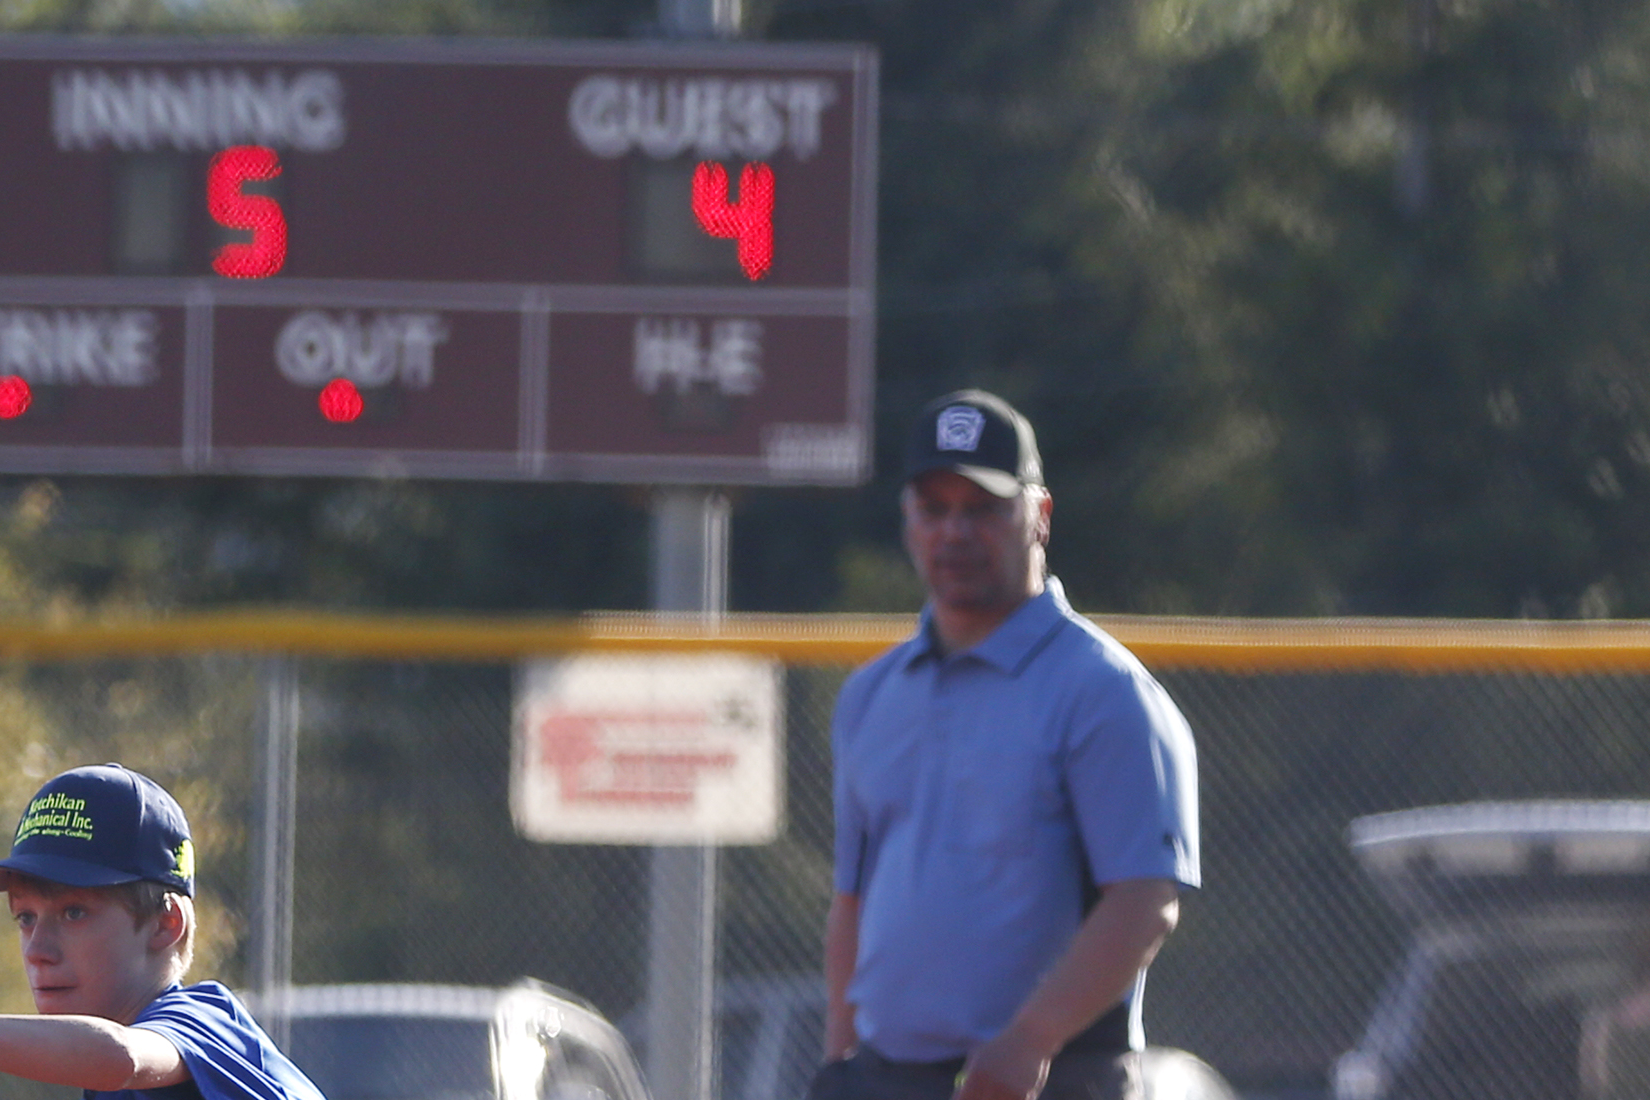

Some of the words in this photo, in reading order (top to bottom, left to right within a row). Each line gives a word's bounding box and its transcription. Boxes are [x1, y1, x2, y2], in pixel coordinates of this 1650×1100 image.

[52, 68, 346, 152] INNING
[568, 74, 836, 160] GUEST
[207, 145, 288, 278] 5
[691, 159, 775, 281] 4
[275, 312, 446, 389] OUT
[72, 812, 93, 829] Inc.
